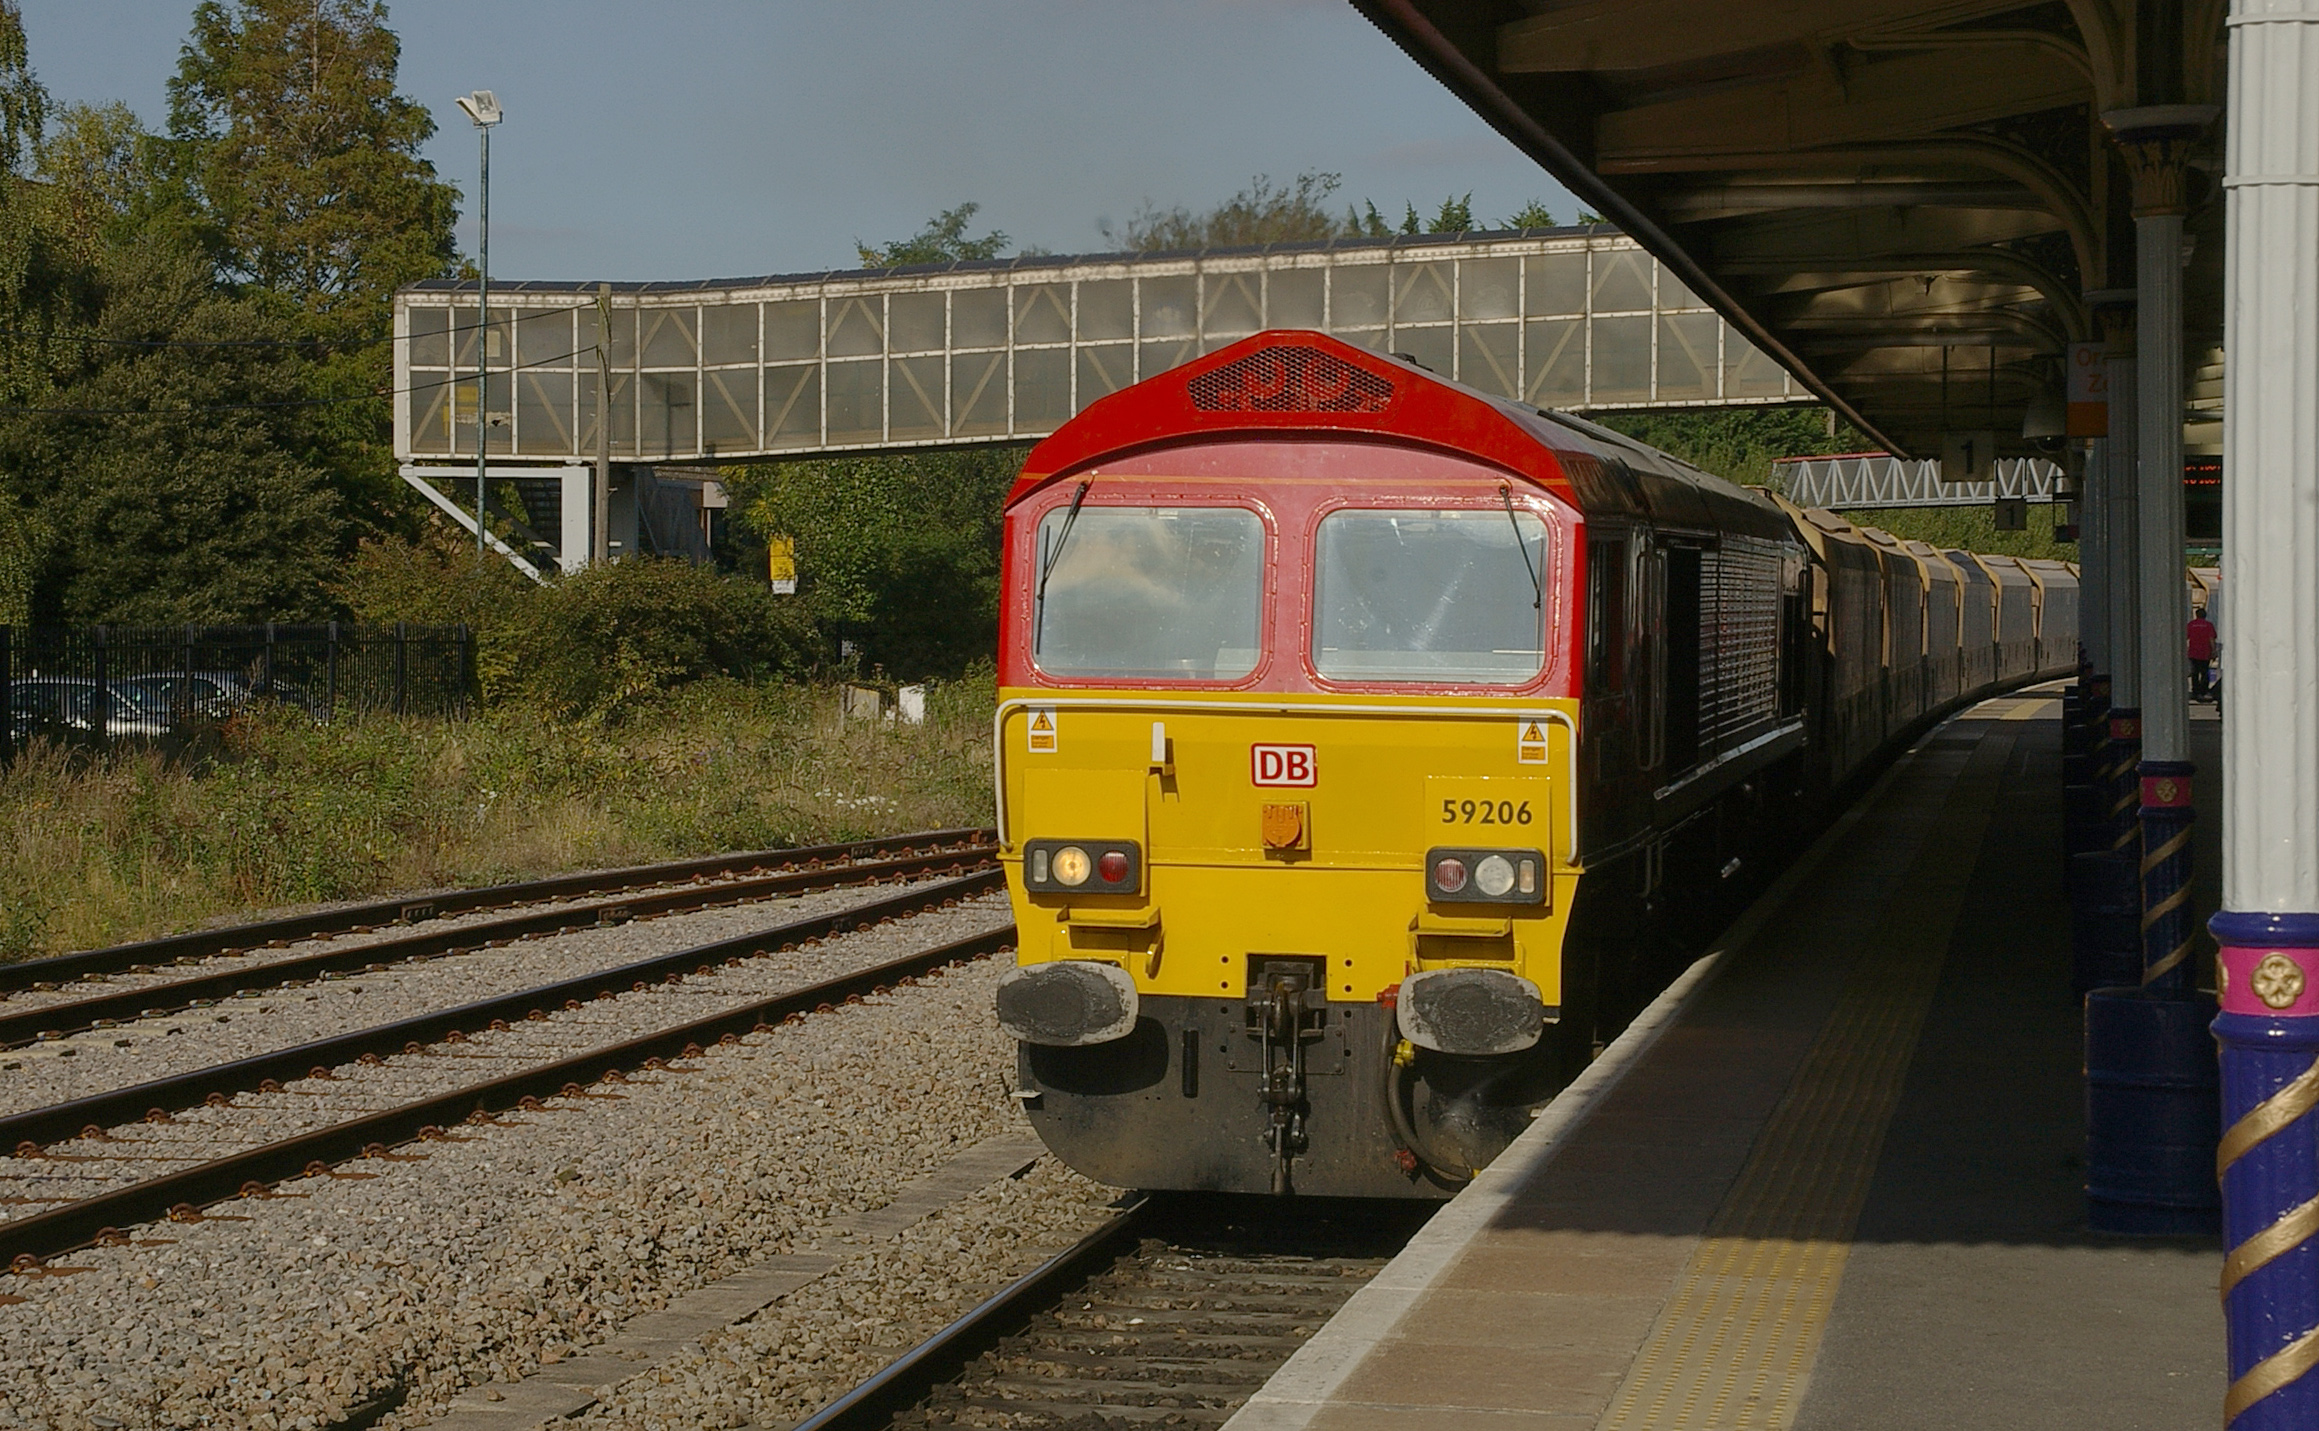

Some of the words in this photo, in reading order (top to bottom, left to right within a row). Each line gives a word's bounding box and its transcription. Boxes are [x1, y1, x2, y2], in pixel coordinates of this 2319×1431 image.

[1960, 440, 1974, 474] 1
[2006, 504, 2015, 527] 1
[1260, 750, 1309, 780] DB
[1442, 799, 1532, 825] 59206
